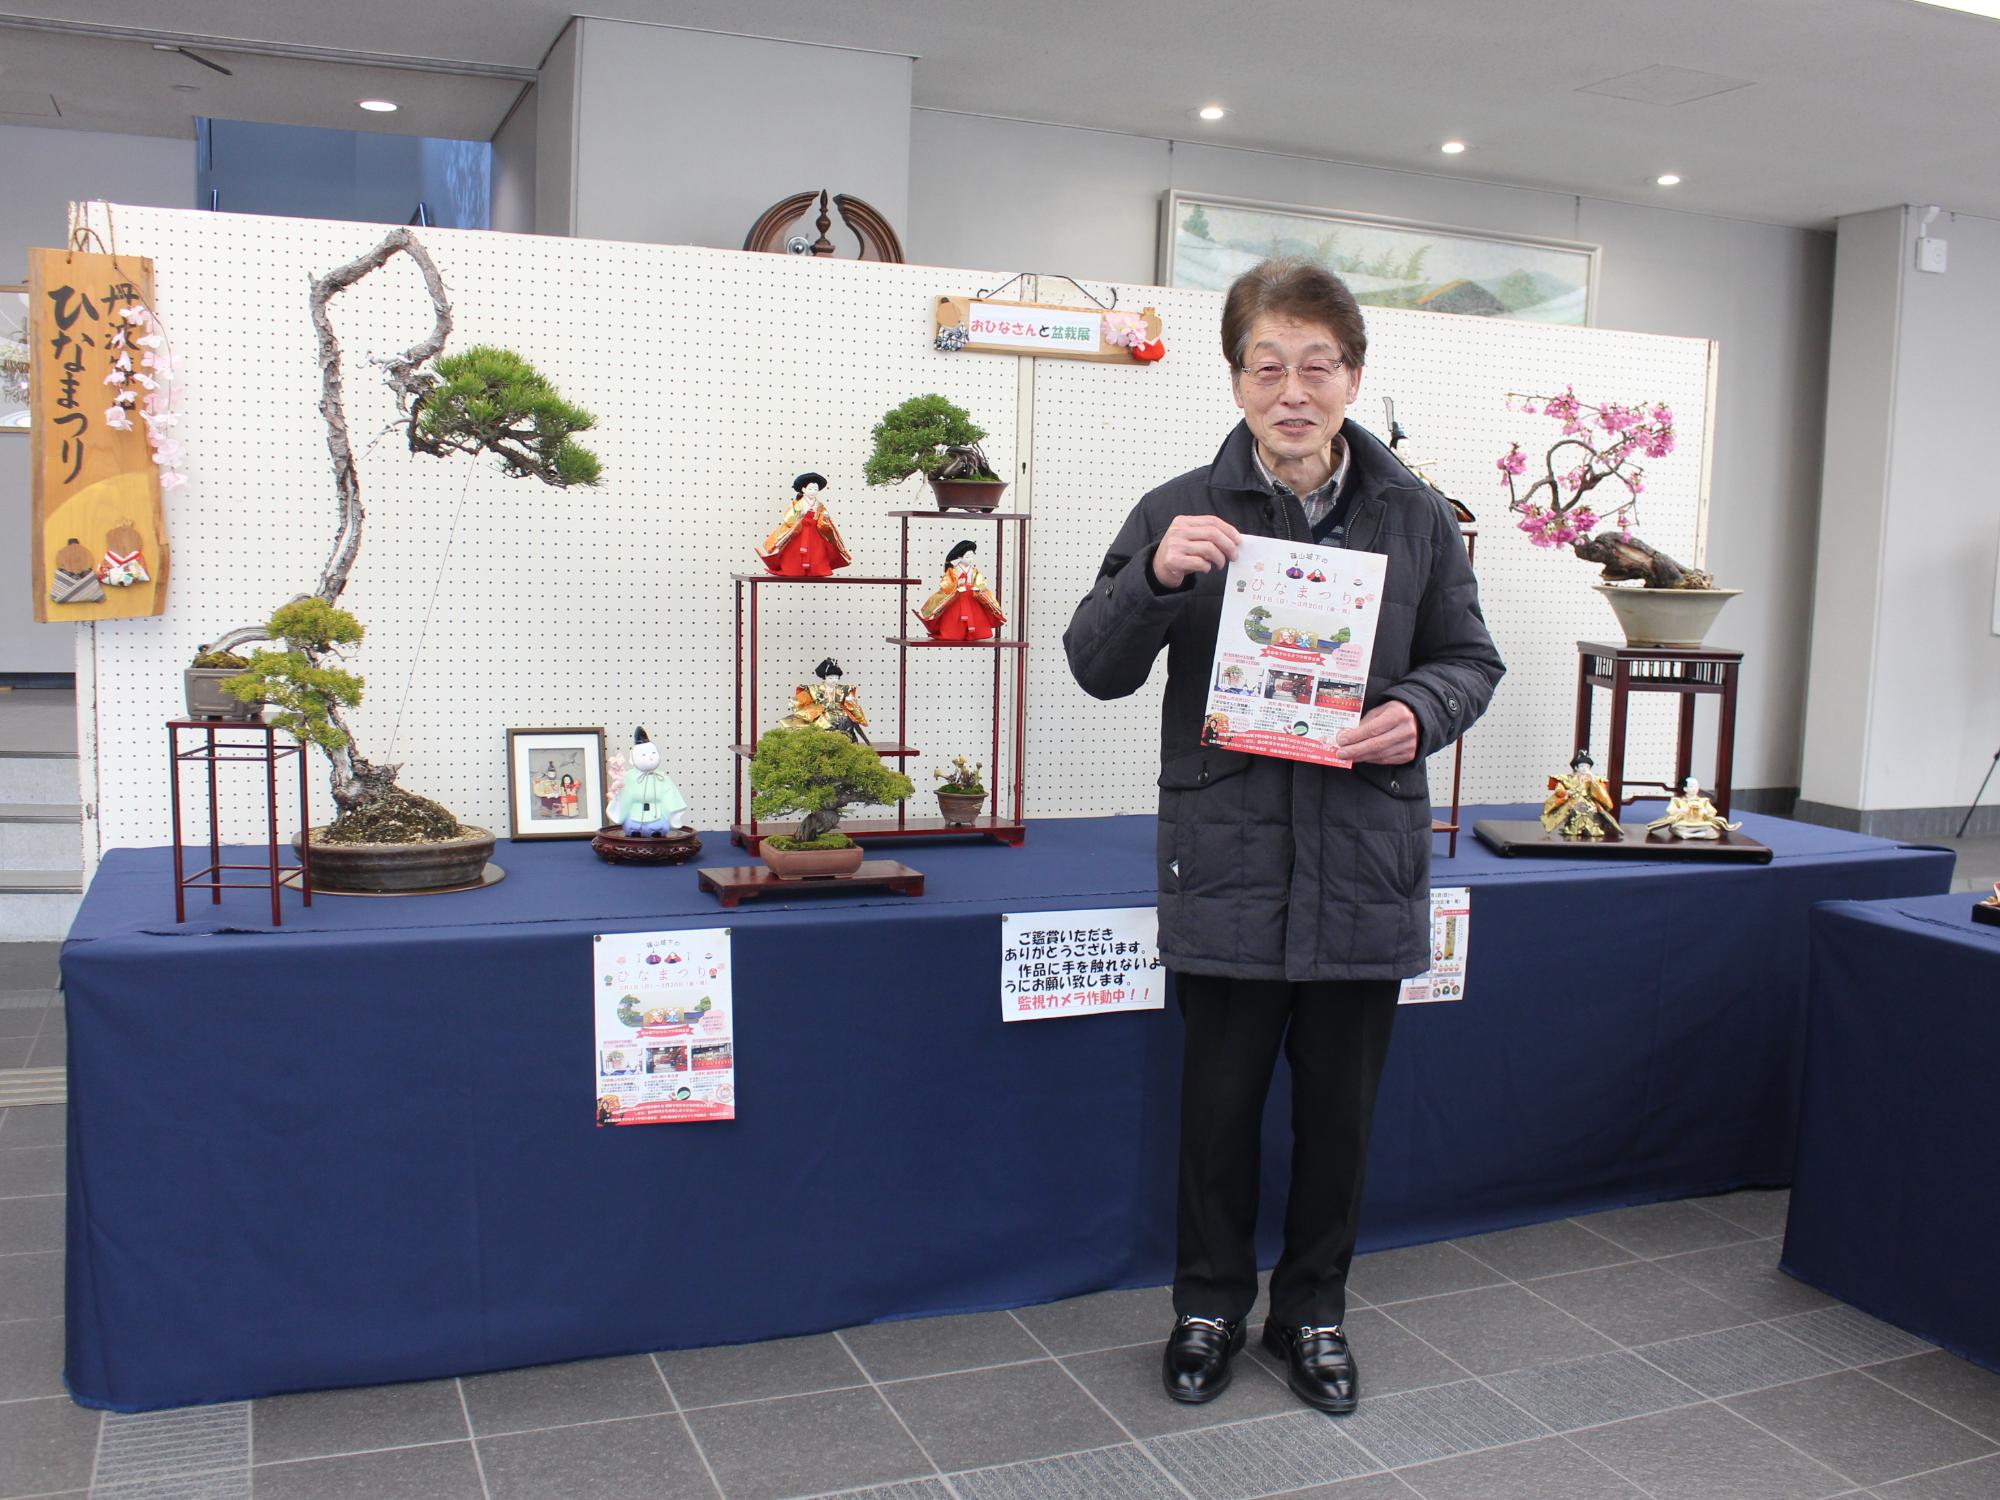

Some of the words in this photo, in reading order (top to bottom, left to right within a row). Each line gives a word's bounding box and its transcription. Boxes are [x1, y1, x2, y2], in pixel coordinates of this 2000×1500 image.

[970, 319, 1091, 341] おひなさんと盆栽展
[48, 285, 100, 484] ひなまつり
[1251, 577, 1352, 605] ひなまつり
[1018, 928, 1114, 946] ご鑑賞いただき
[1004, 941, 1146, 962] ありがとうございます。
[1018, 957, 1160, 979] 作品に手を触れないよ
[1004, 972, 1132, 994] うにお願い致します。
